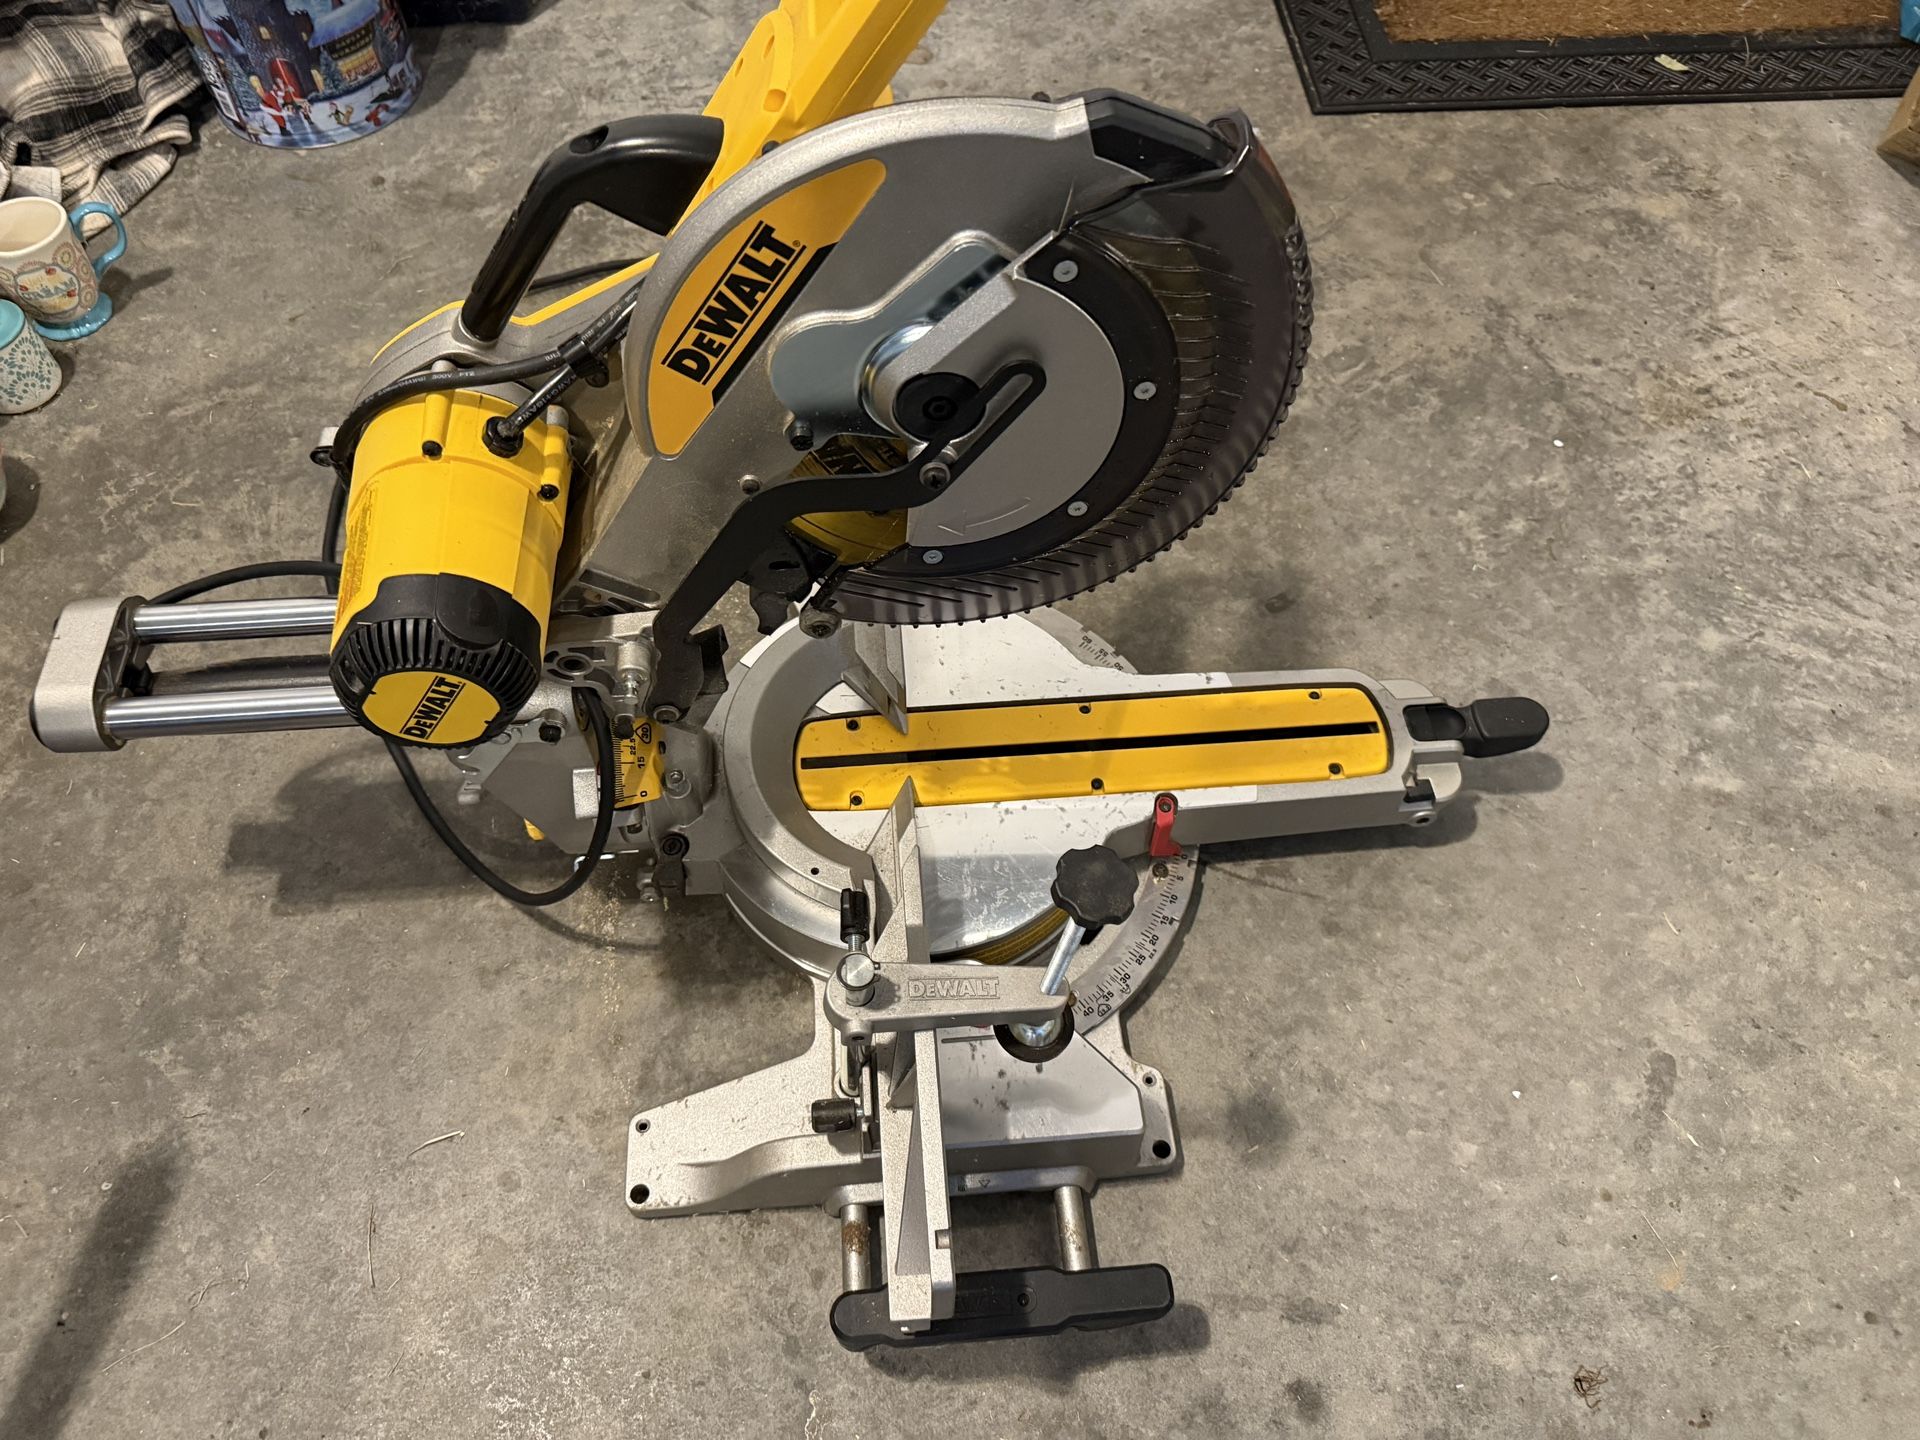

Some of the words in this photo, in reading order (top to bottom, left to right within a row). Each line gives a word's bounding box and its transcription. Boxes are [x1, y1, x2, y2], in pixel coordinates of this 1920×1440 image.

[667, 223, 797, 383] DEWALT
[403, 676, 461, 739] DEWALT
[641, 726, 649, 739] 30
[637, 756, 646, 769] 15
[640, 790, 648, 798] 0
[1176, 874, 1184, 882] 5
[1169, 894, 1178, 905] 10
[1159, 915, 1170, 926] 15
[1149, 934, 1159, 946] 20
[1136, 954, 1146, 965] 25
[1119, 973, 1130, 984] 30
[908, 979, 1000, 998] DEWALT
[1103, 991, 1114, 1002] 35
[1083, 1006, 1094, 1017] 40
